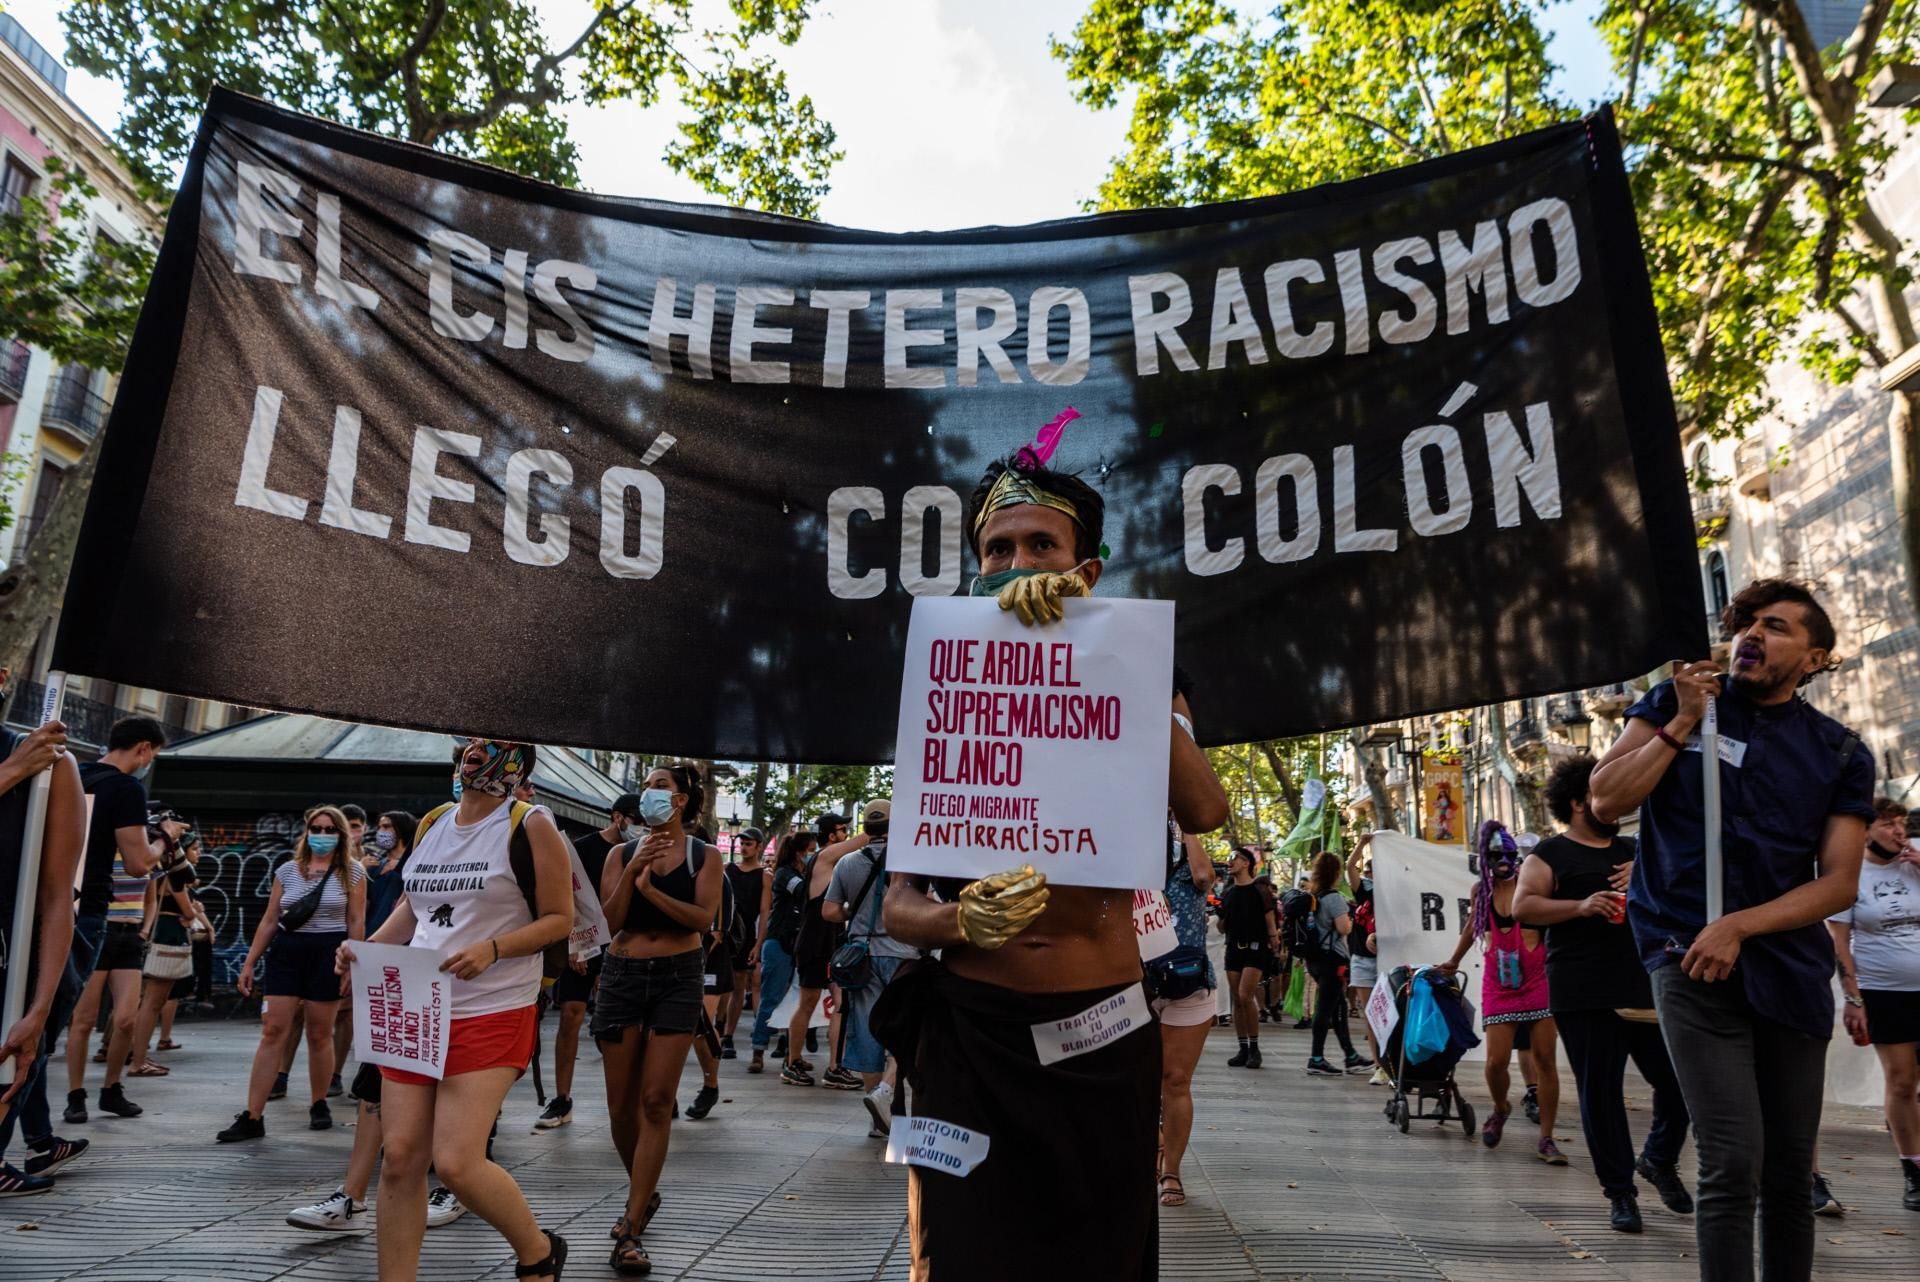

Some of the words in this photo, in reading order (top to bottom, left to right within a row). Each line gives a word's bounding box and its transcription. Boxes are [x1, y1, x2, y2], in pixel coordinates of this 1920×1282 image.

[234, 160, 380, 310] EL
[428, 229, 598, 363] CIS
[648, 277, 1091, 389] HETERO
[1128, 197, 1582, 376] RACISMO
[235, 386, 677, 580] LLEGÓ
[827, 485, 962, 599] CO
[1181, 380, 1563, 577] COLÓN
[929, 639, 979, 688] QUE
[981, 640, 1044, 686] ARDA
[1049, 643, 1081, 687] EL
[926, 690, 1121, 741] SUPREMACISMO
[922, 738, 1023, 787] BLANCO
[920, 793, 965, 817] FUEGO
[969, 795, 1040, 821] MIGRANTE
[405, 876, 485, 893] ANTICOLONIAL
[438, 862, 489, 874] RESISTENCIA
[367, 983, 385, 997] EL
[369, 999, 387, 1029] ARDA
[383, 965, 404, 1057] SUPREMACISMO
[1056, 995, 1126, 1032] TRAICIONA
[1089, 1020, 1103, 1034] TU
[371, 1029, 389, 1056] QUE
[403, 1011, 420, 1060] BLANCO
[1061, 1018, 1131, 1053] BLANQUITUD
[923, 1134, 936, 1147] TU
